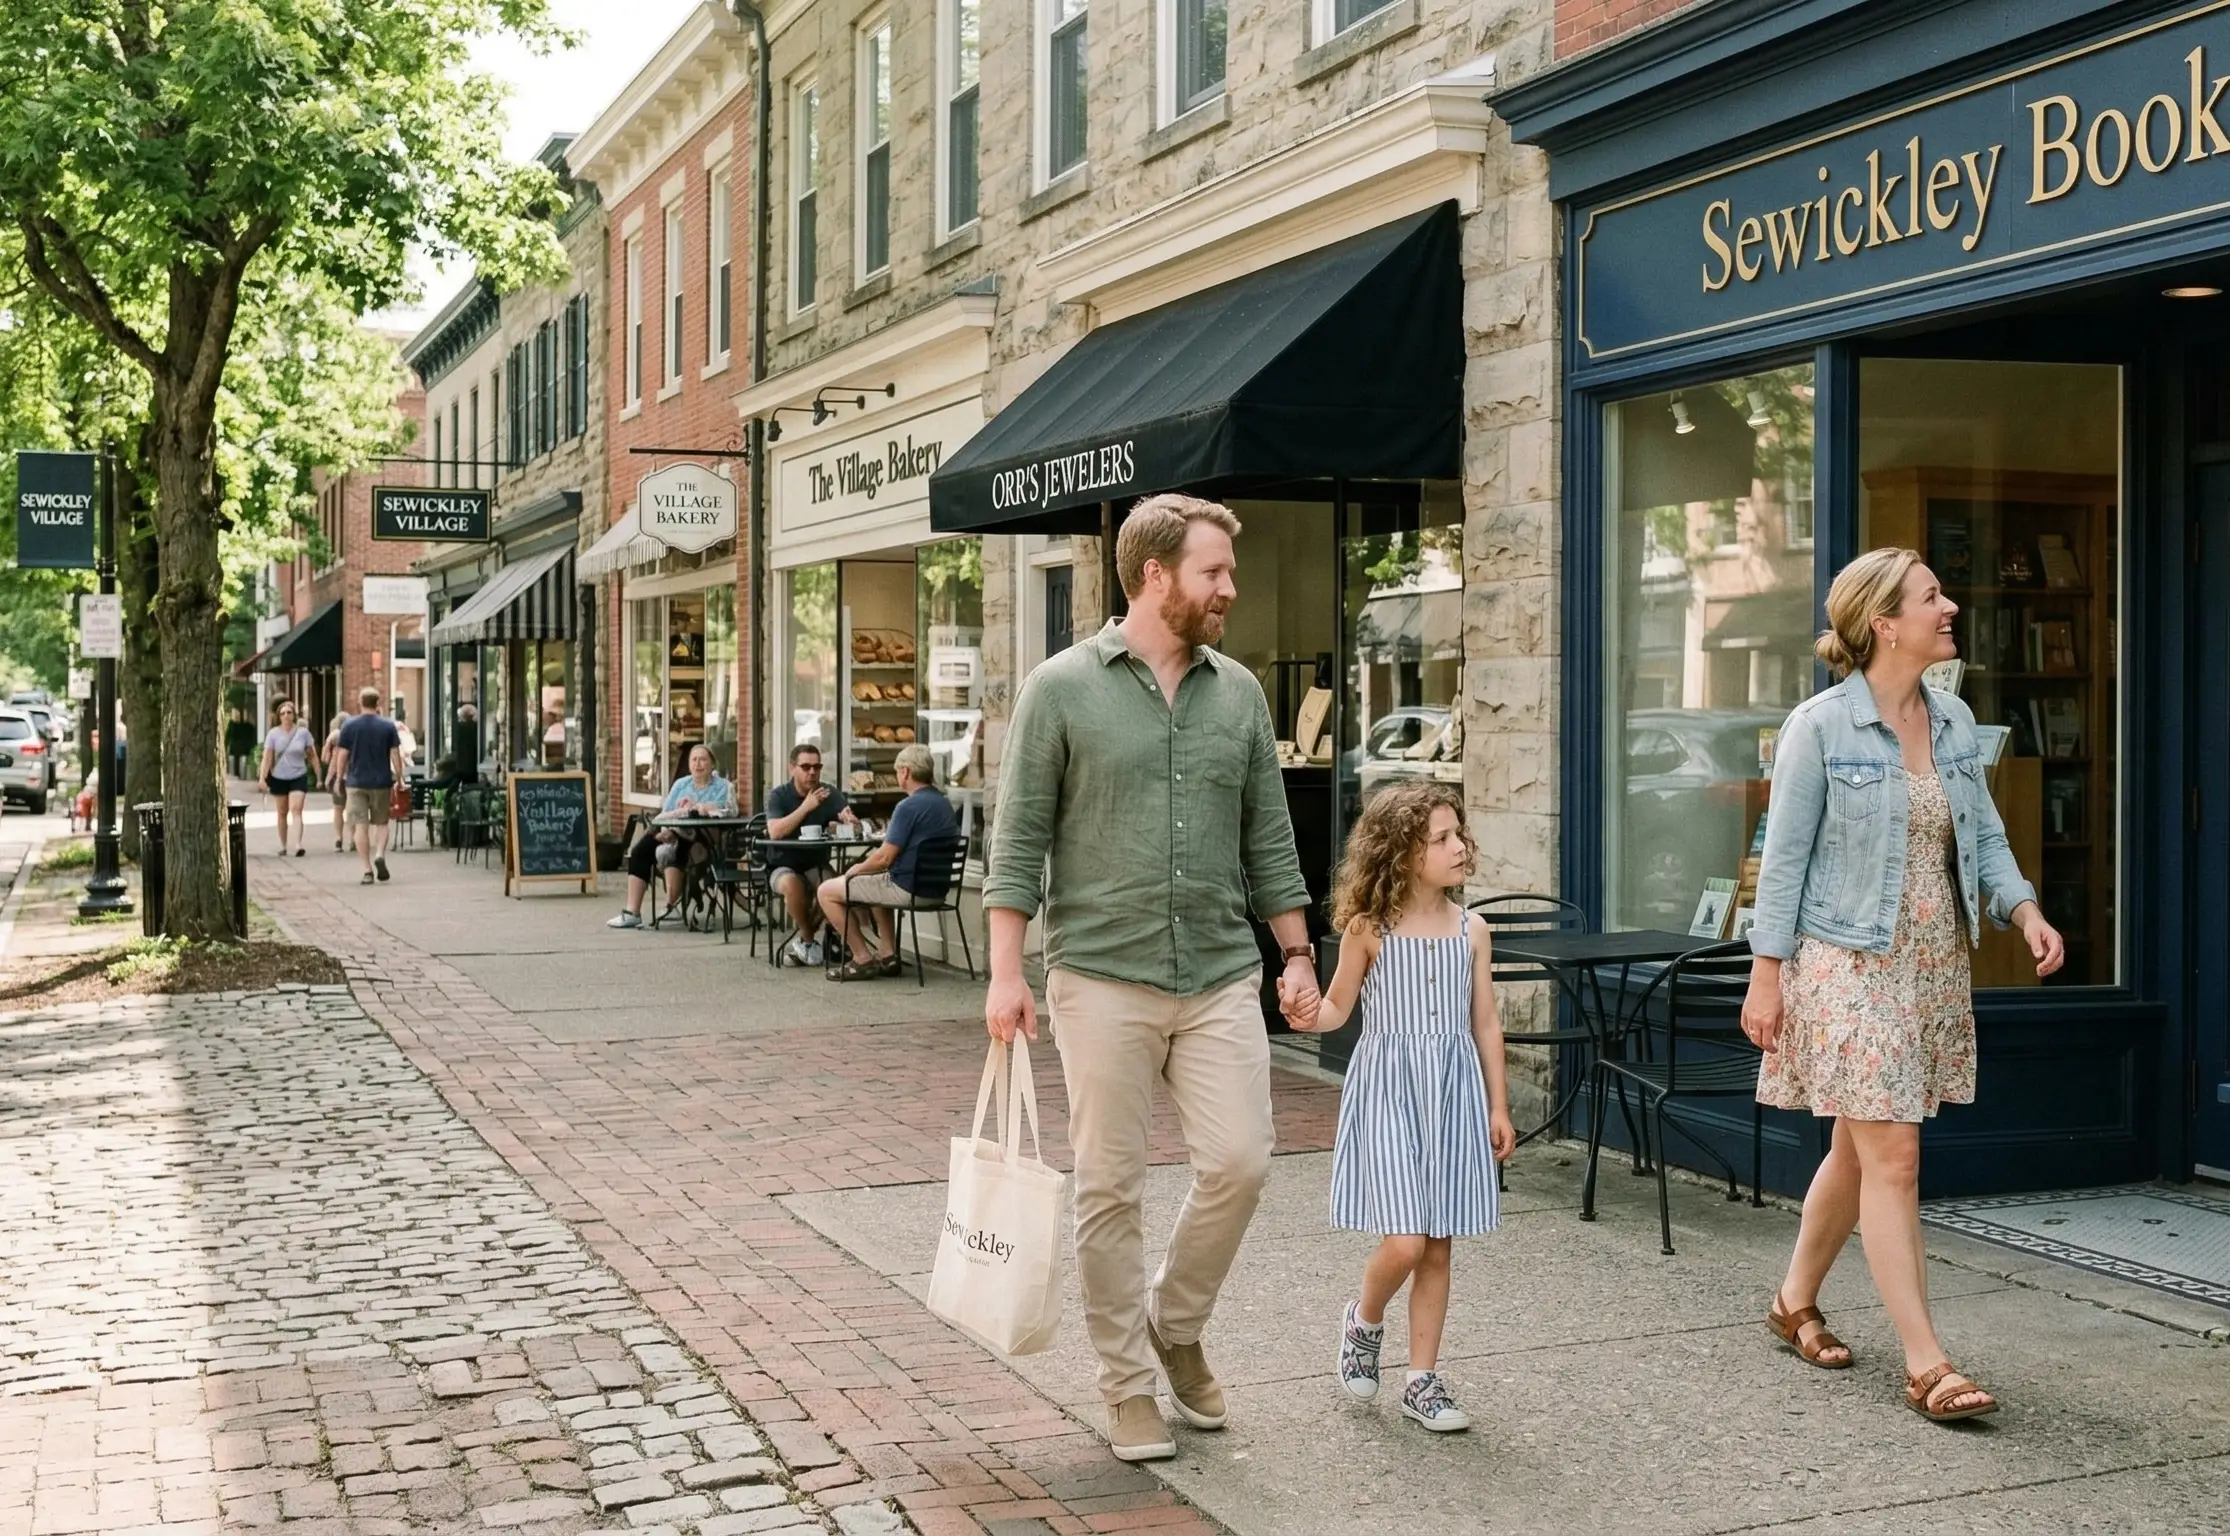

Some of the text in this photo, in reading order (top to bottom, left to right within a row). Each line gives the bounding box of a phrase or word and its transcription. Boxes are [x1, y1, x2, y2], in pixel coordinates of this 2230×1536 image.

[1702, 135, 2003, 293] Sewickley
[808, 434, 943, 504] The Village Bakery
[992, 440, 1135, 510] ORR'S JEWELERS
[675, 482, 698, 492] THE
[21, 493, 92, 509] SEWICKLEY
[382, 495, 482, 515] SEWICKLEY
[653, 494, 723, 509] VILLAGE
[30, 511, 84, 526] VILLAGE
[394, 515, 470, 533] VILLAGE
[656, 511, 720, 525] BAKERY
